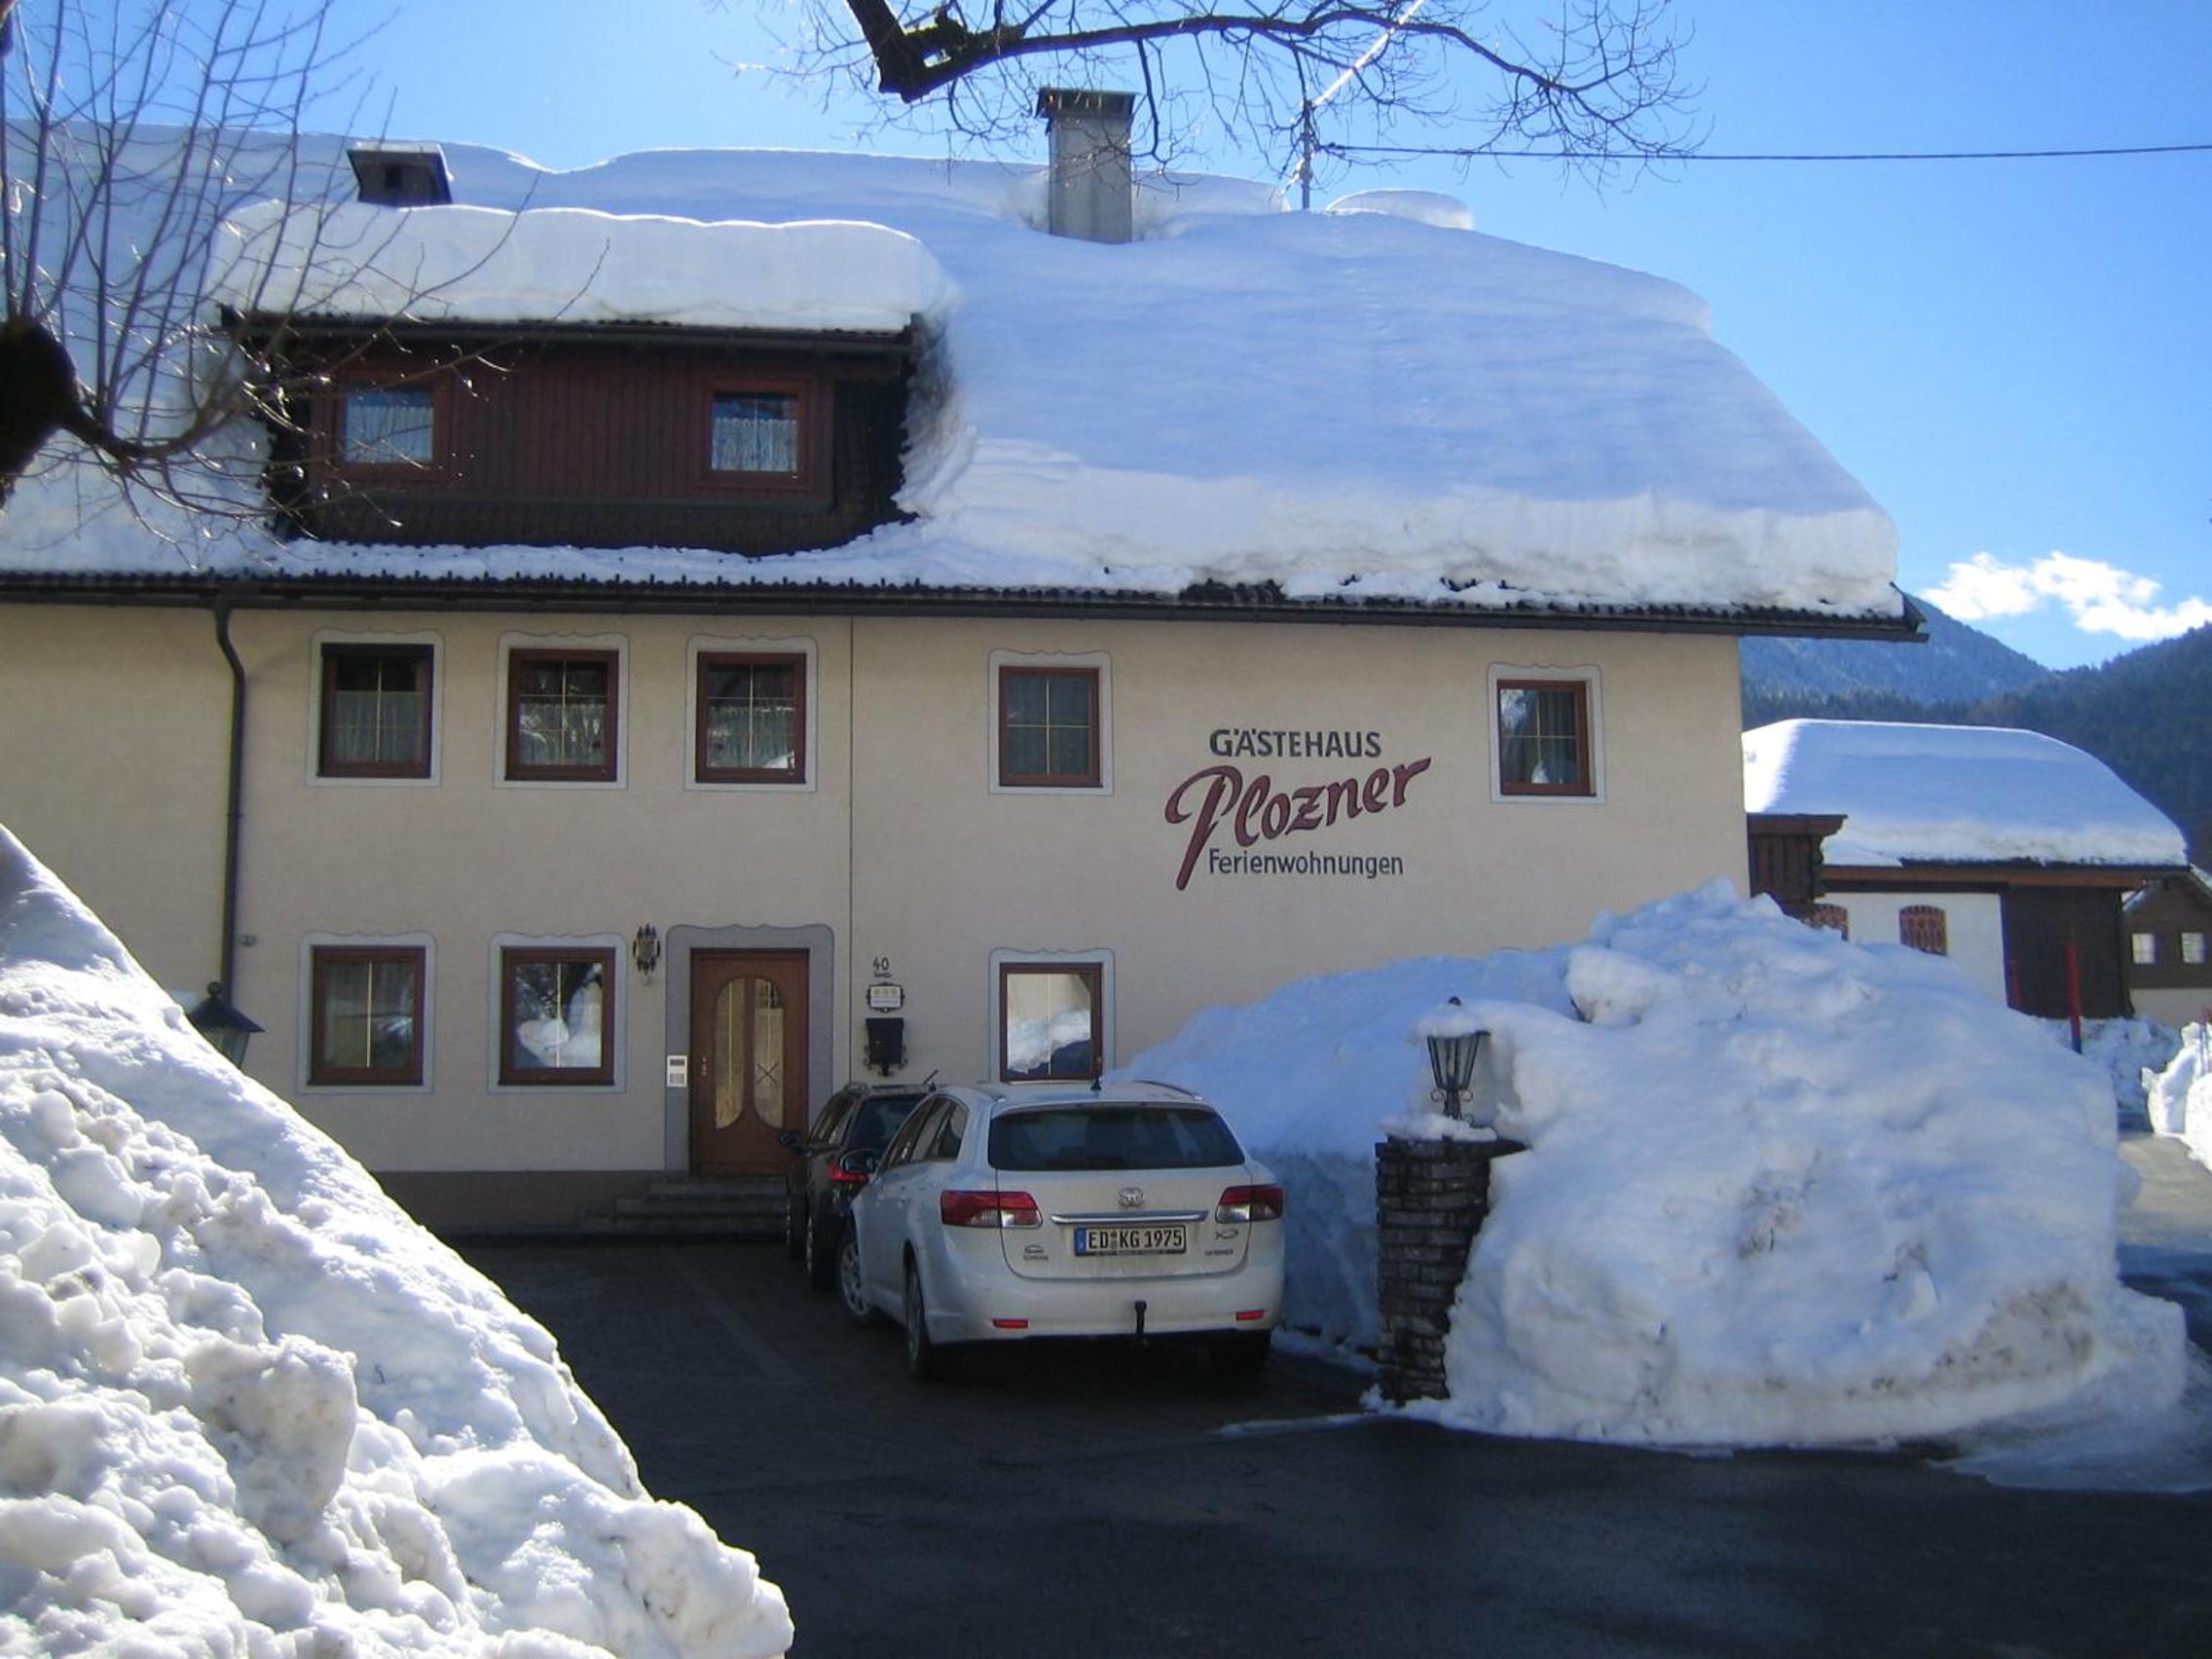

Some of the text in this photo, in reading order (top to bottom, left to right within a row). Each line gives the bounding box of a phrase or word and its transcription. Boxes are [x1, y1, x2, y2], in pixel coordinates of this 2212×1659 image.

[1209, 728, 1382, 757] GÄSTEHAUS
[1164, 756, 1432, 891] Plozner
[1208, 848, 1404, 879] Ferienwohnungen
[872, 956, 890, 971] 40
[1088, 1229, 1183, 1249] ED KG 1975
